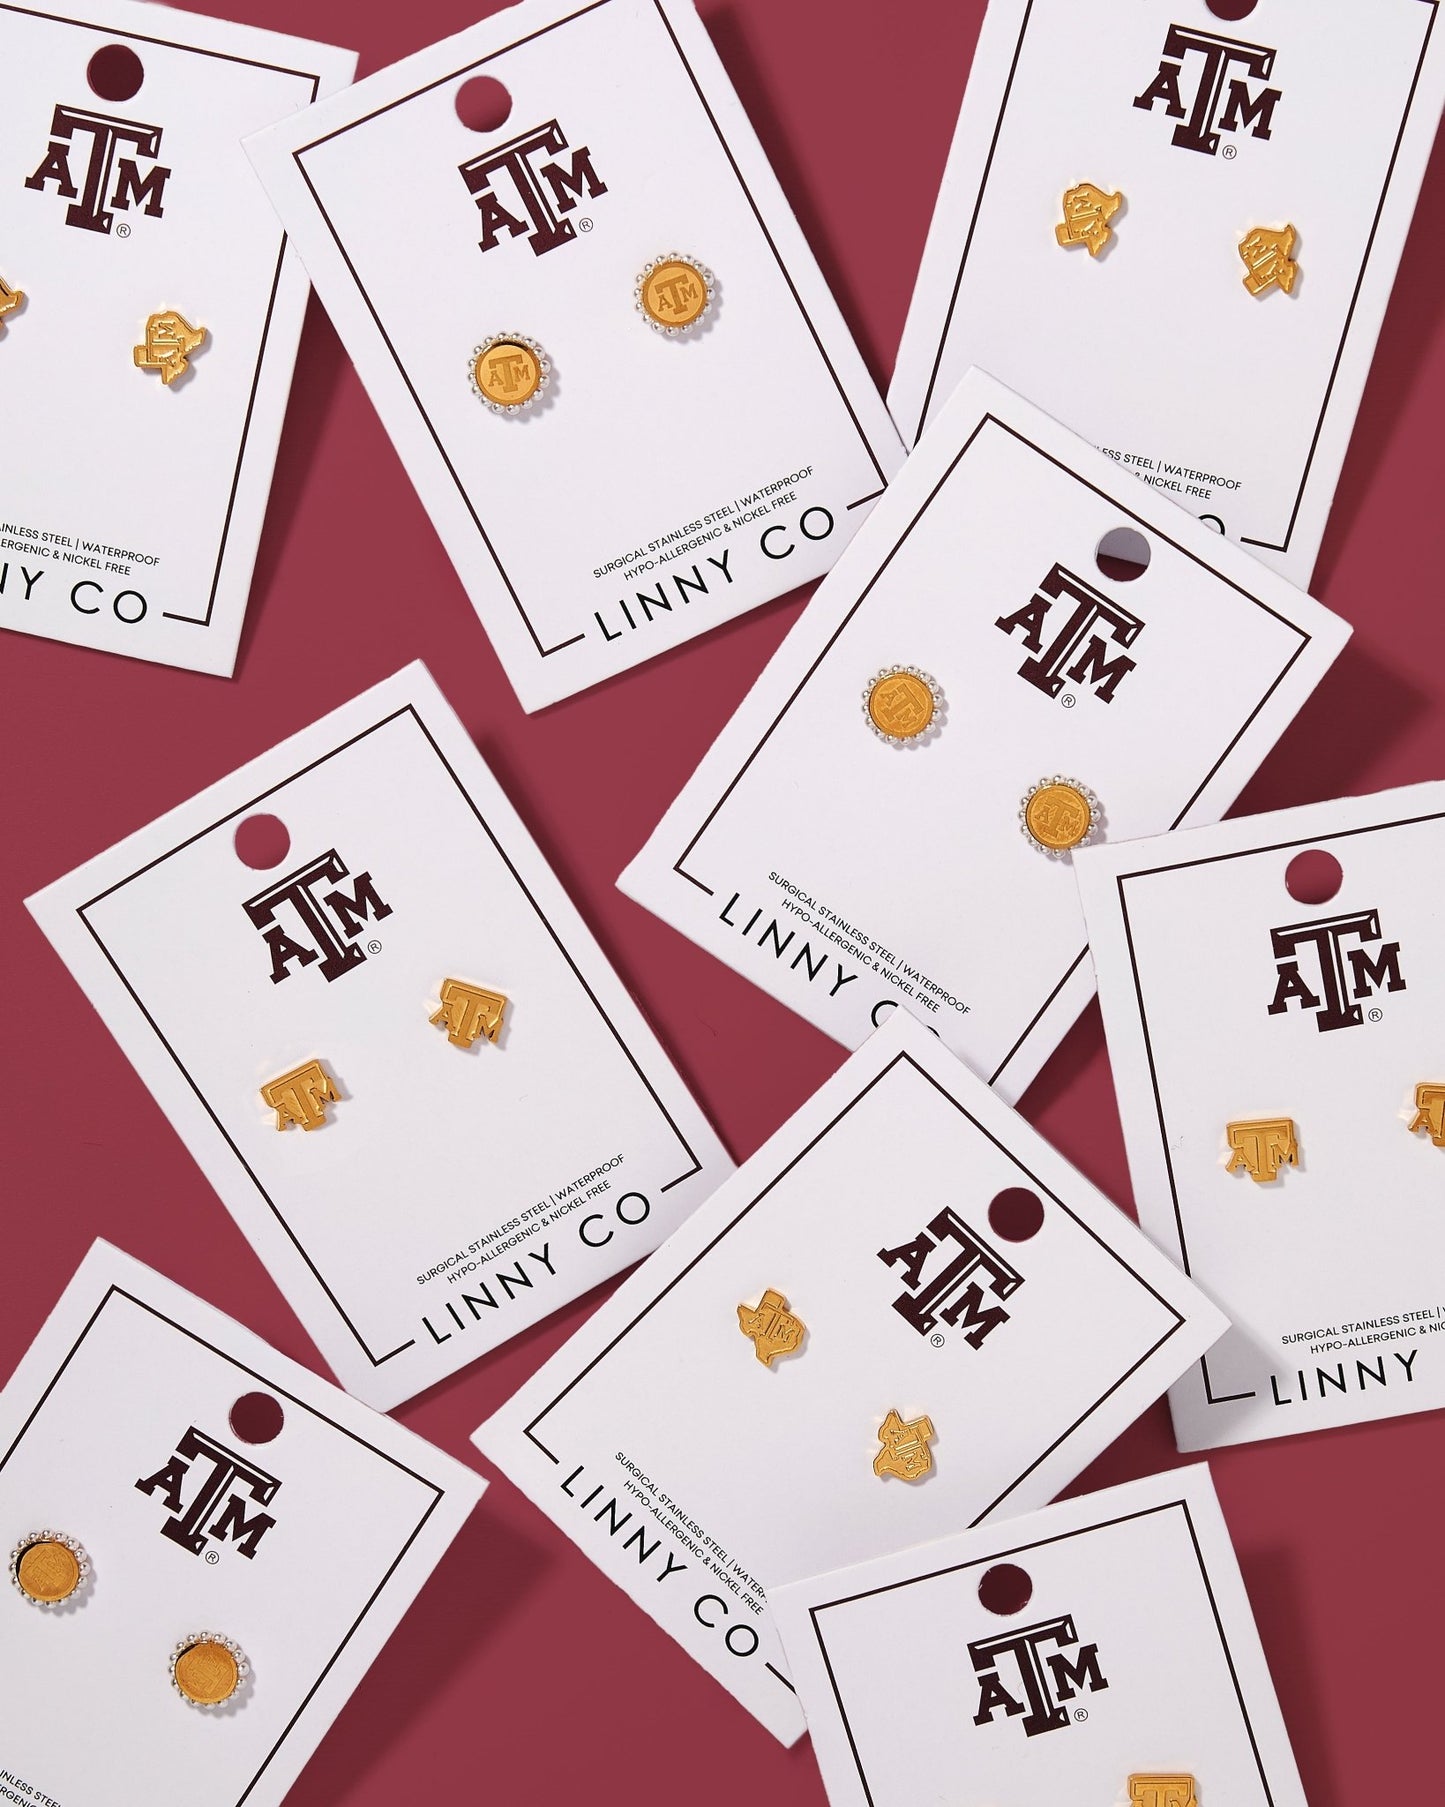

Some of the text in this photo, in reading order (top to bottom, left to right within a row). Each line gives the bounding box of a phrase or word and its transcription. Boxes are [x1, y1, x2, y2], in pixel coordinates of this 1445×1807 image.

[594, 548, 648, 578] SURGICAL
[648, 520, 702, 552] STAINLESS
[704, 506, 735, 524] STEEL
[740, 466, 812, 506] WATERPROOF
[1124, 454, 1154, 469] STEEL
[1165, 464, 1241, 490] WATERPROOF
[1144, 475, 1211, 499] NICKEL FREE
[42, 533, 72, 547] STEEL
[83, 541, 159, 566] WATERPROOF
[53, 550, 59, 559] &
[63, 553, 101, 569] NICKEL
[105, 562, 131, 575] FREE
[594, 507, 834, 641] LINNY CO
[624, 491, 797, 580] HYPO-ALLERGENIC & NICKEL FREE
[71, 581, 147, 624] CO
[719, 893, 858, 996] LINNY
[769, 872, 816, 910] SURGICAL
[818, 907, 869, 945] STAINLESS
[869, 942, 895, 965] STEEL
[904, 964, 970, 1014] WATERPROOF
[782, 899, 940, 1013] HYPO-ALLERGENIC & NICKEL FREE
[417, 1252, 469, 1284] SURGICAL
[468, 1218, 520, 1253] STAINLESS
[521, 1201, 551, 1221] STEEL
[555, 1154, 623, 1199] WATERPROOF
[422, 1193, 650, 1344] LINNY CO
[447, 1180, 611, 1283] HYPO-ALLERGENIC & NICKEL FREE
[1270, 1350, 1416, 1406] LINNY
[1282, 1327, 1339, 1344] SURGICAL
[1342, 1316, 1400, 1333] STAINLESS
[1403, 1310, 1434, 1322] STEEL
[1311, 1327, 1416, 1354] HYPO-ALLERGENIC
[1420, 1326, 1426, 1334] &
[616, 1452, 658, 1496] SURGICAL
[659, 1494, 704, 1538] STAINLESS
[703, 1537, 727, 1563] STEEL
[624, 1480, 763, 1615] HYPO-ALLERGENIC & NICKEL FREE
[560, 1465, 759, 1657] LINNY CO
